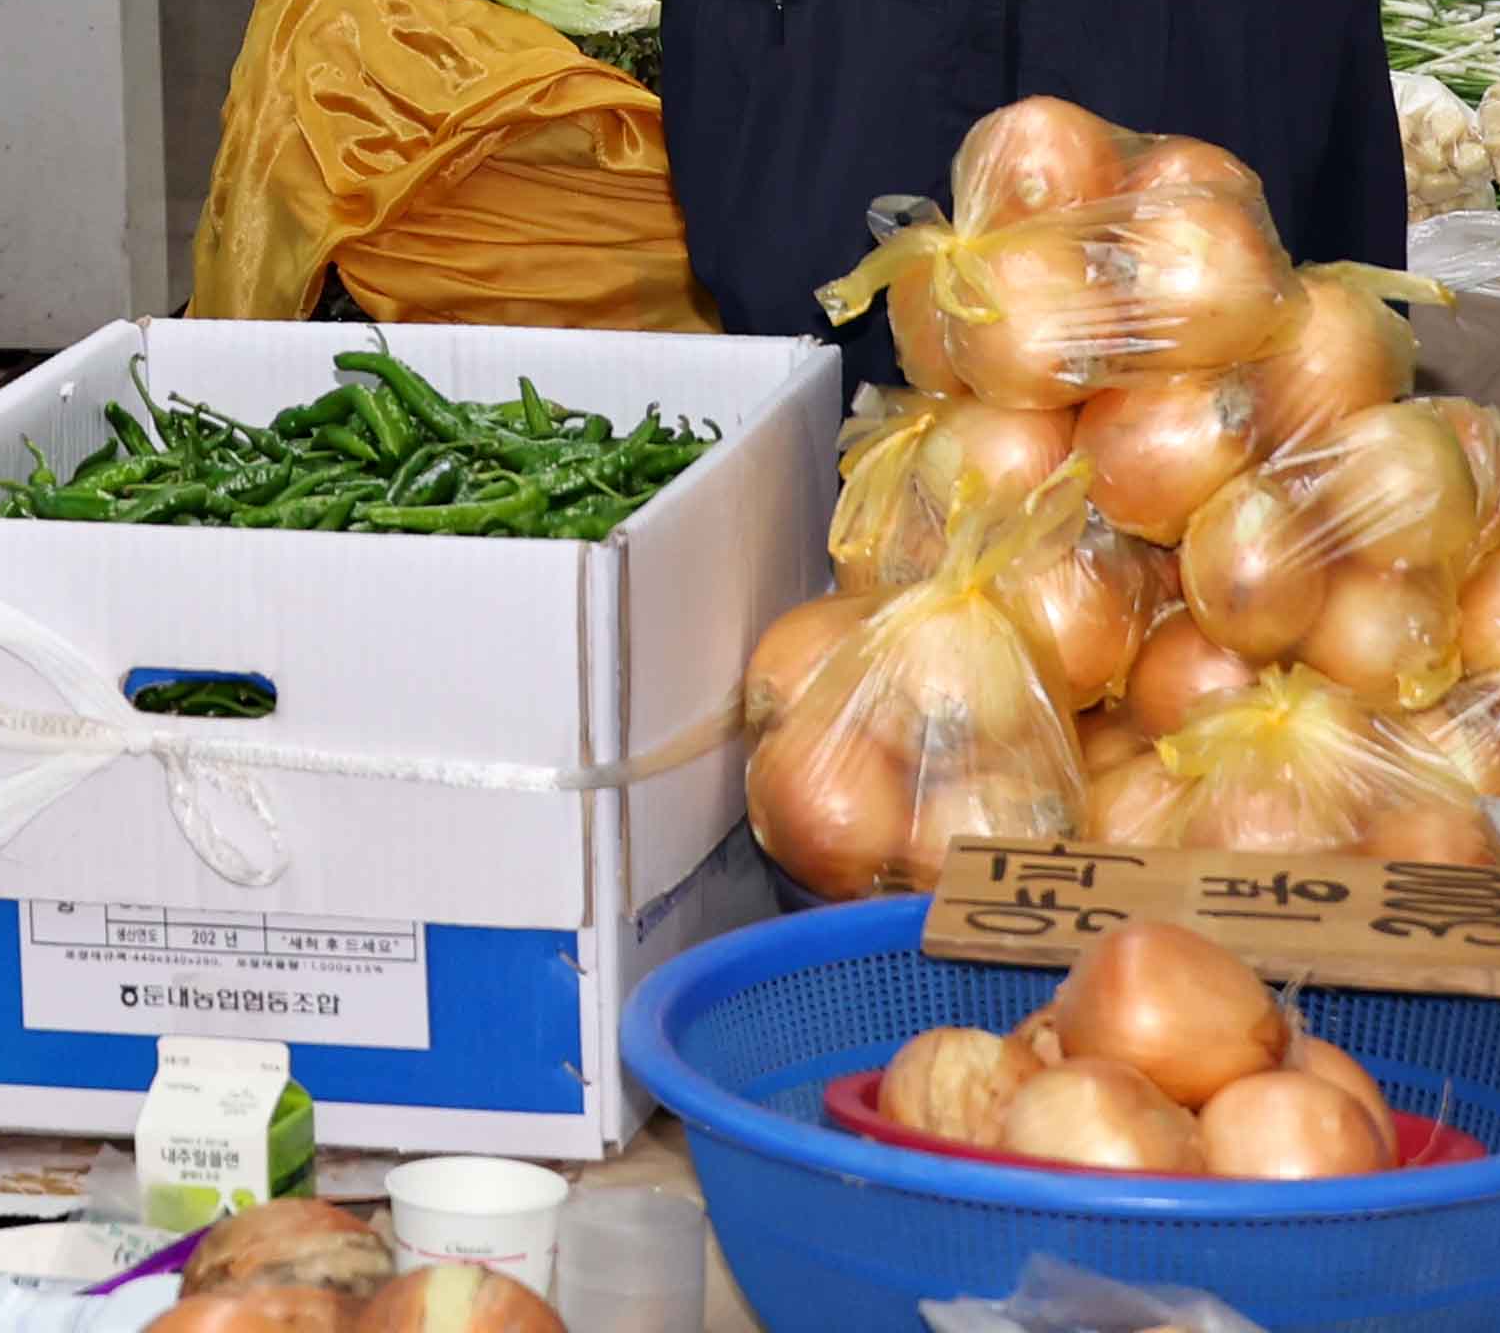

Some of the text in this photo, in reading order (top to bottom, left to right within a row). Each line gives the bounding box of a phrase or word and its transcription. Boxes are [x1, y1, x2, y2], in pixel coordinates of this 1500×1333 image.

[943, 837, 1147, 937] 양파
[191, 930, 217, 947] 202
[224, 930, 240, 949] 년
[142, 983, 342, 1020] 둔내농업협동조합
